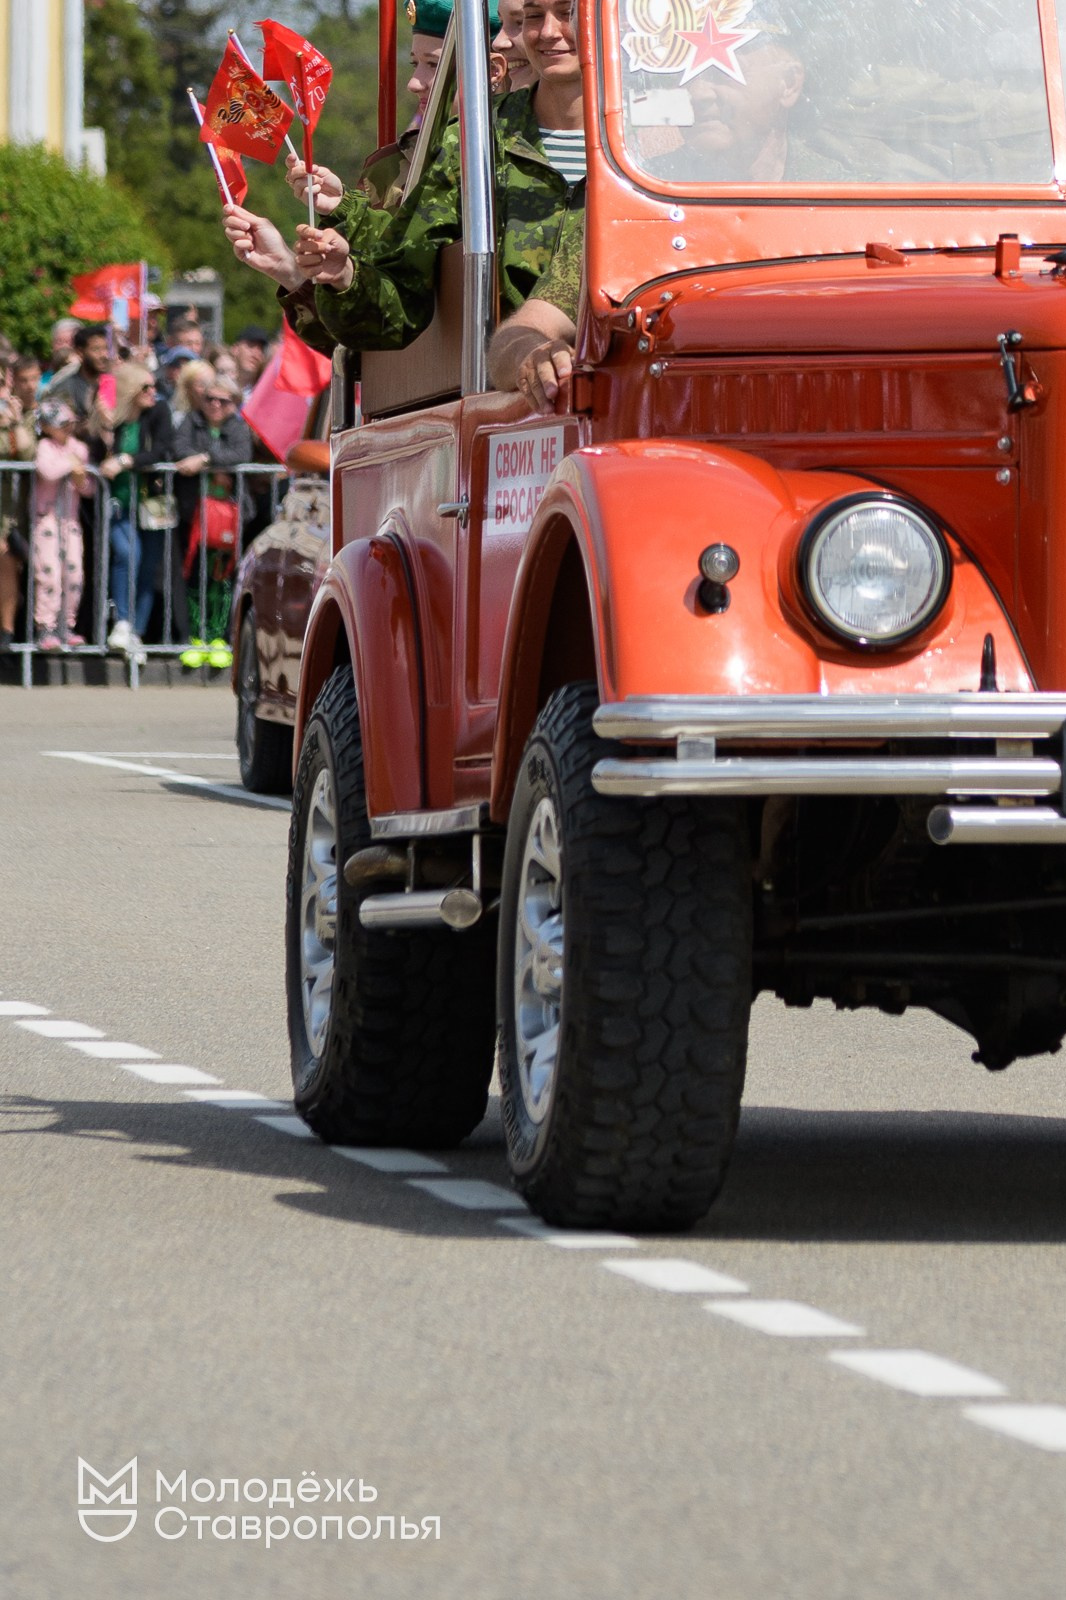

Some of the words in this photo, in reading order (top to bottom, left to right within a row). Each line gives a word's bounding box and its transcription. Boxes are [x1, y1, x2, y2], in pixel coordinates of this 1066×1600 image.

[495, 439, 535, 479] СВОИХ
[541, 436, 557, 474] НЕ
[495, 486, 545, 525] БРОСАЕ
